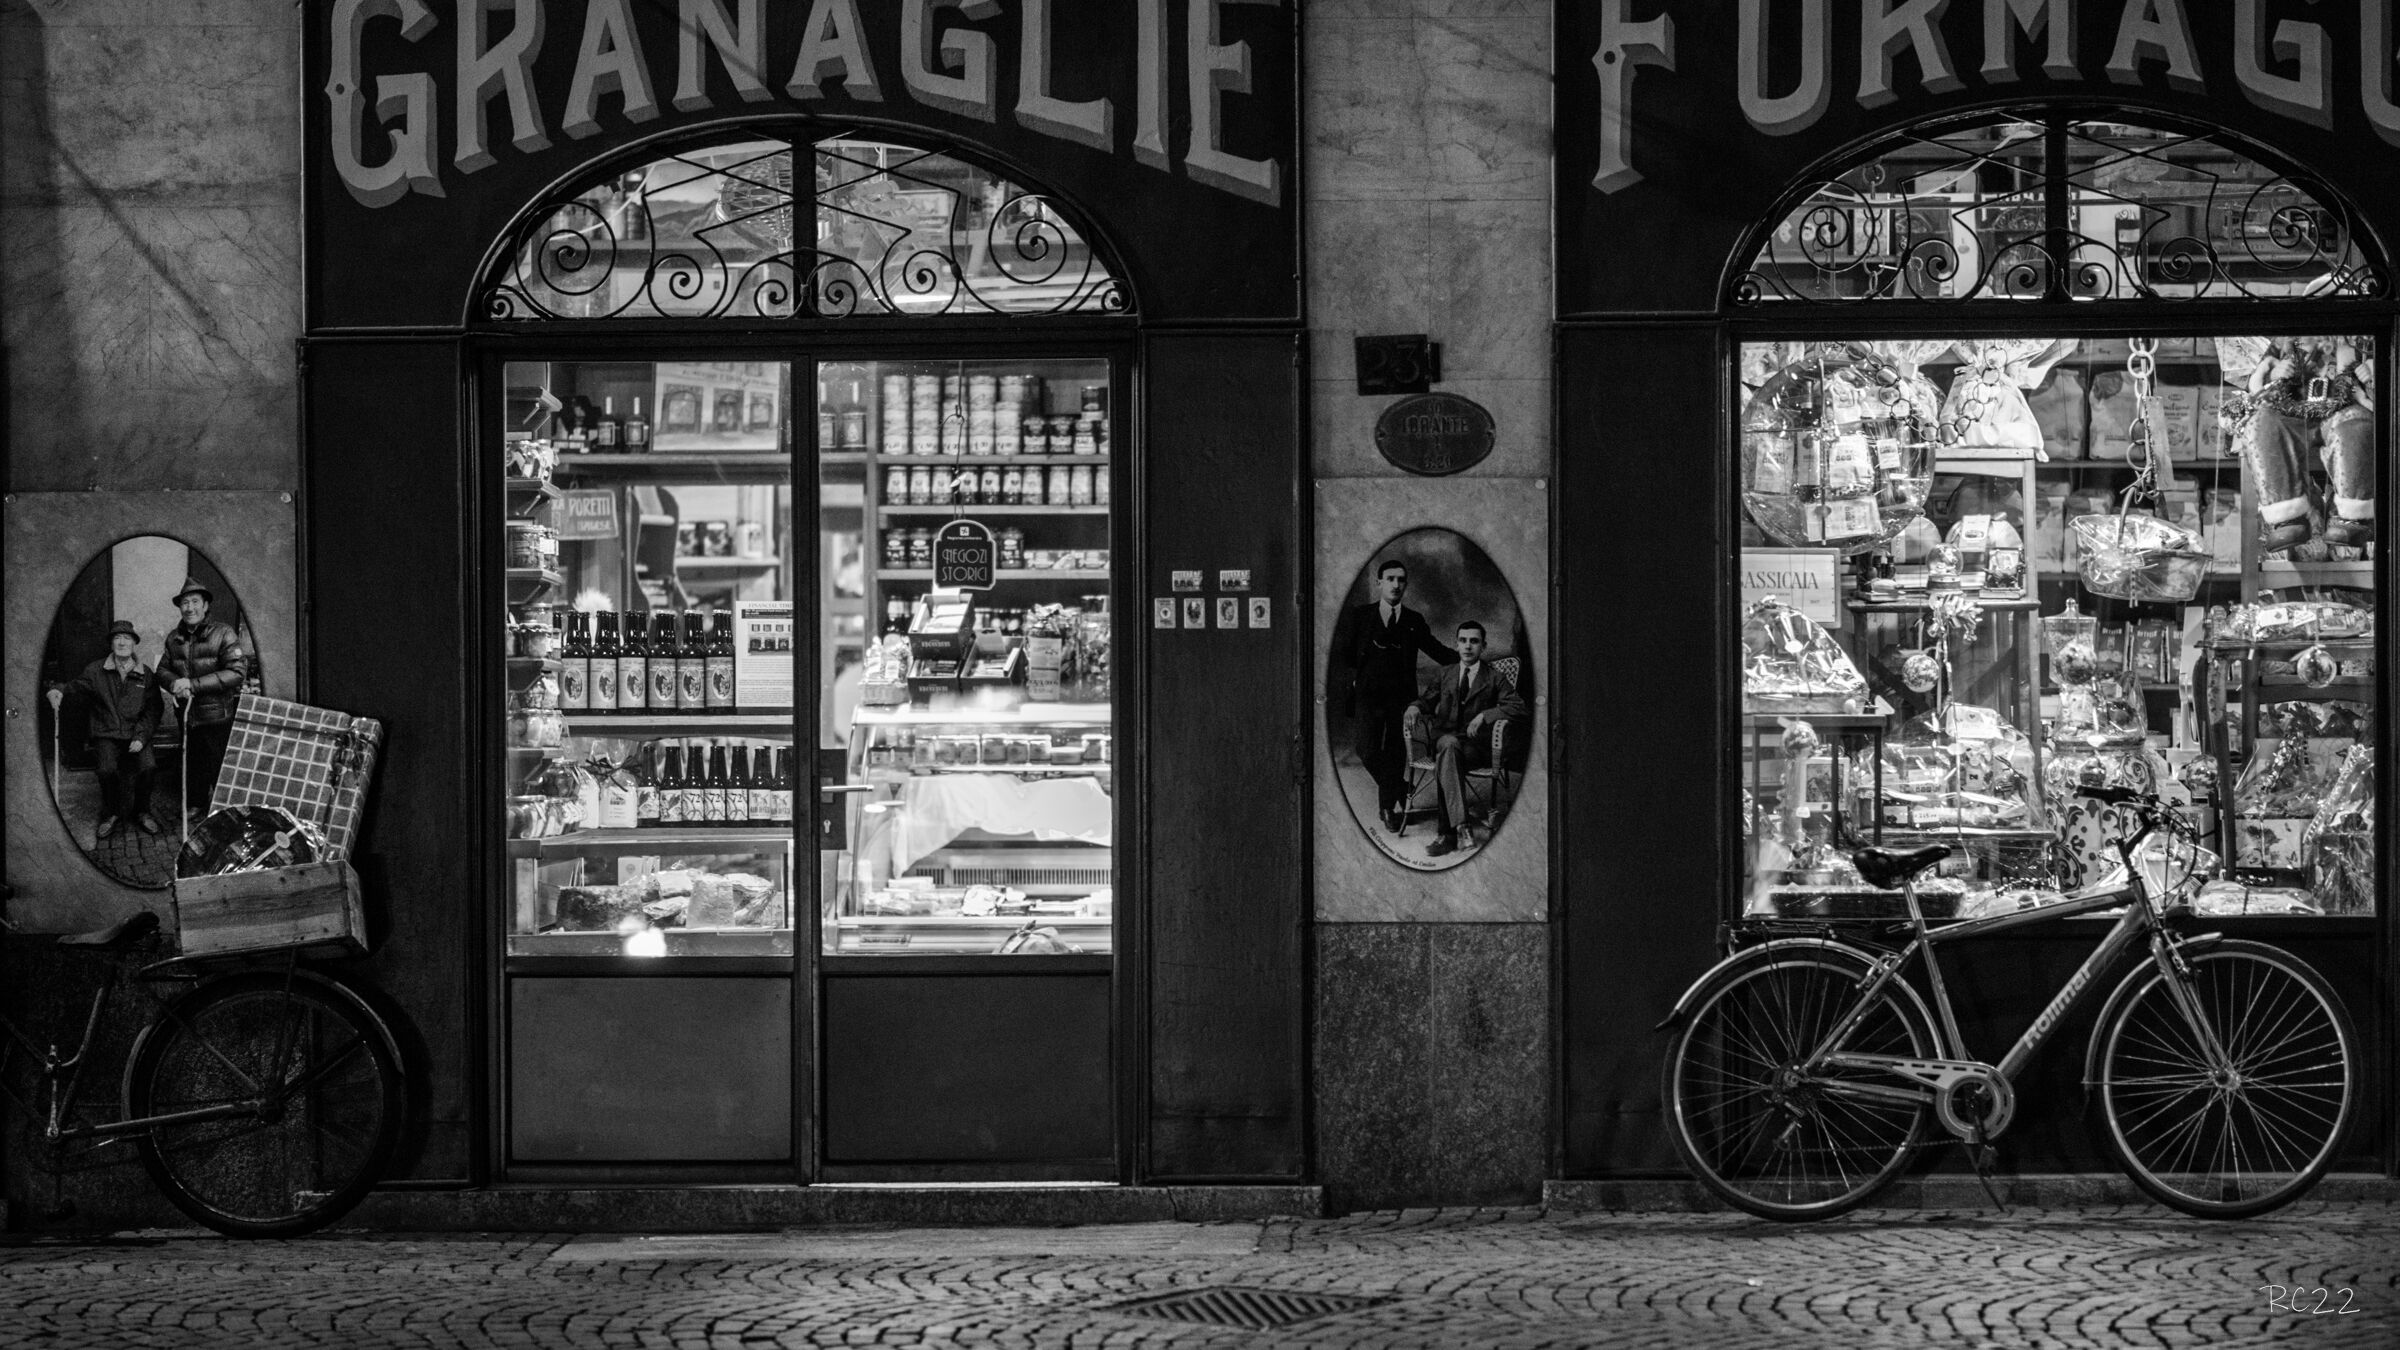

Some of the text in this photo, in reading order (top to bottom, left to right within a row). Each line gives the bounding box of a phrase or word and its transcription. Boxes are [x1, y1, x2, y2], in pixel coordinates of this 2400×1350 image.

[325, 0, 1283, 208] GRANAGLIE
[1592, 0, 2400, 195] FORMAG
[1362, 344, 1420, 387] 23
[1402, 415, 1470, 433] IDRANTE
[568, 497, 610, 516] PORETTI
[942, 549, 987, 564] NEGOZI
[942, 567, 987, 581] STORICI
[1741, 571, 1819, 590] ASSICAIA
